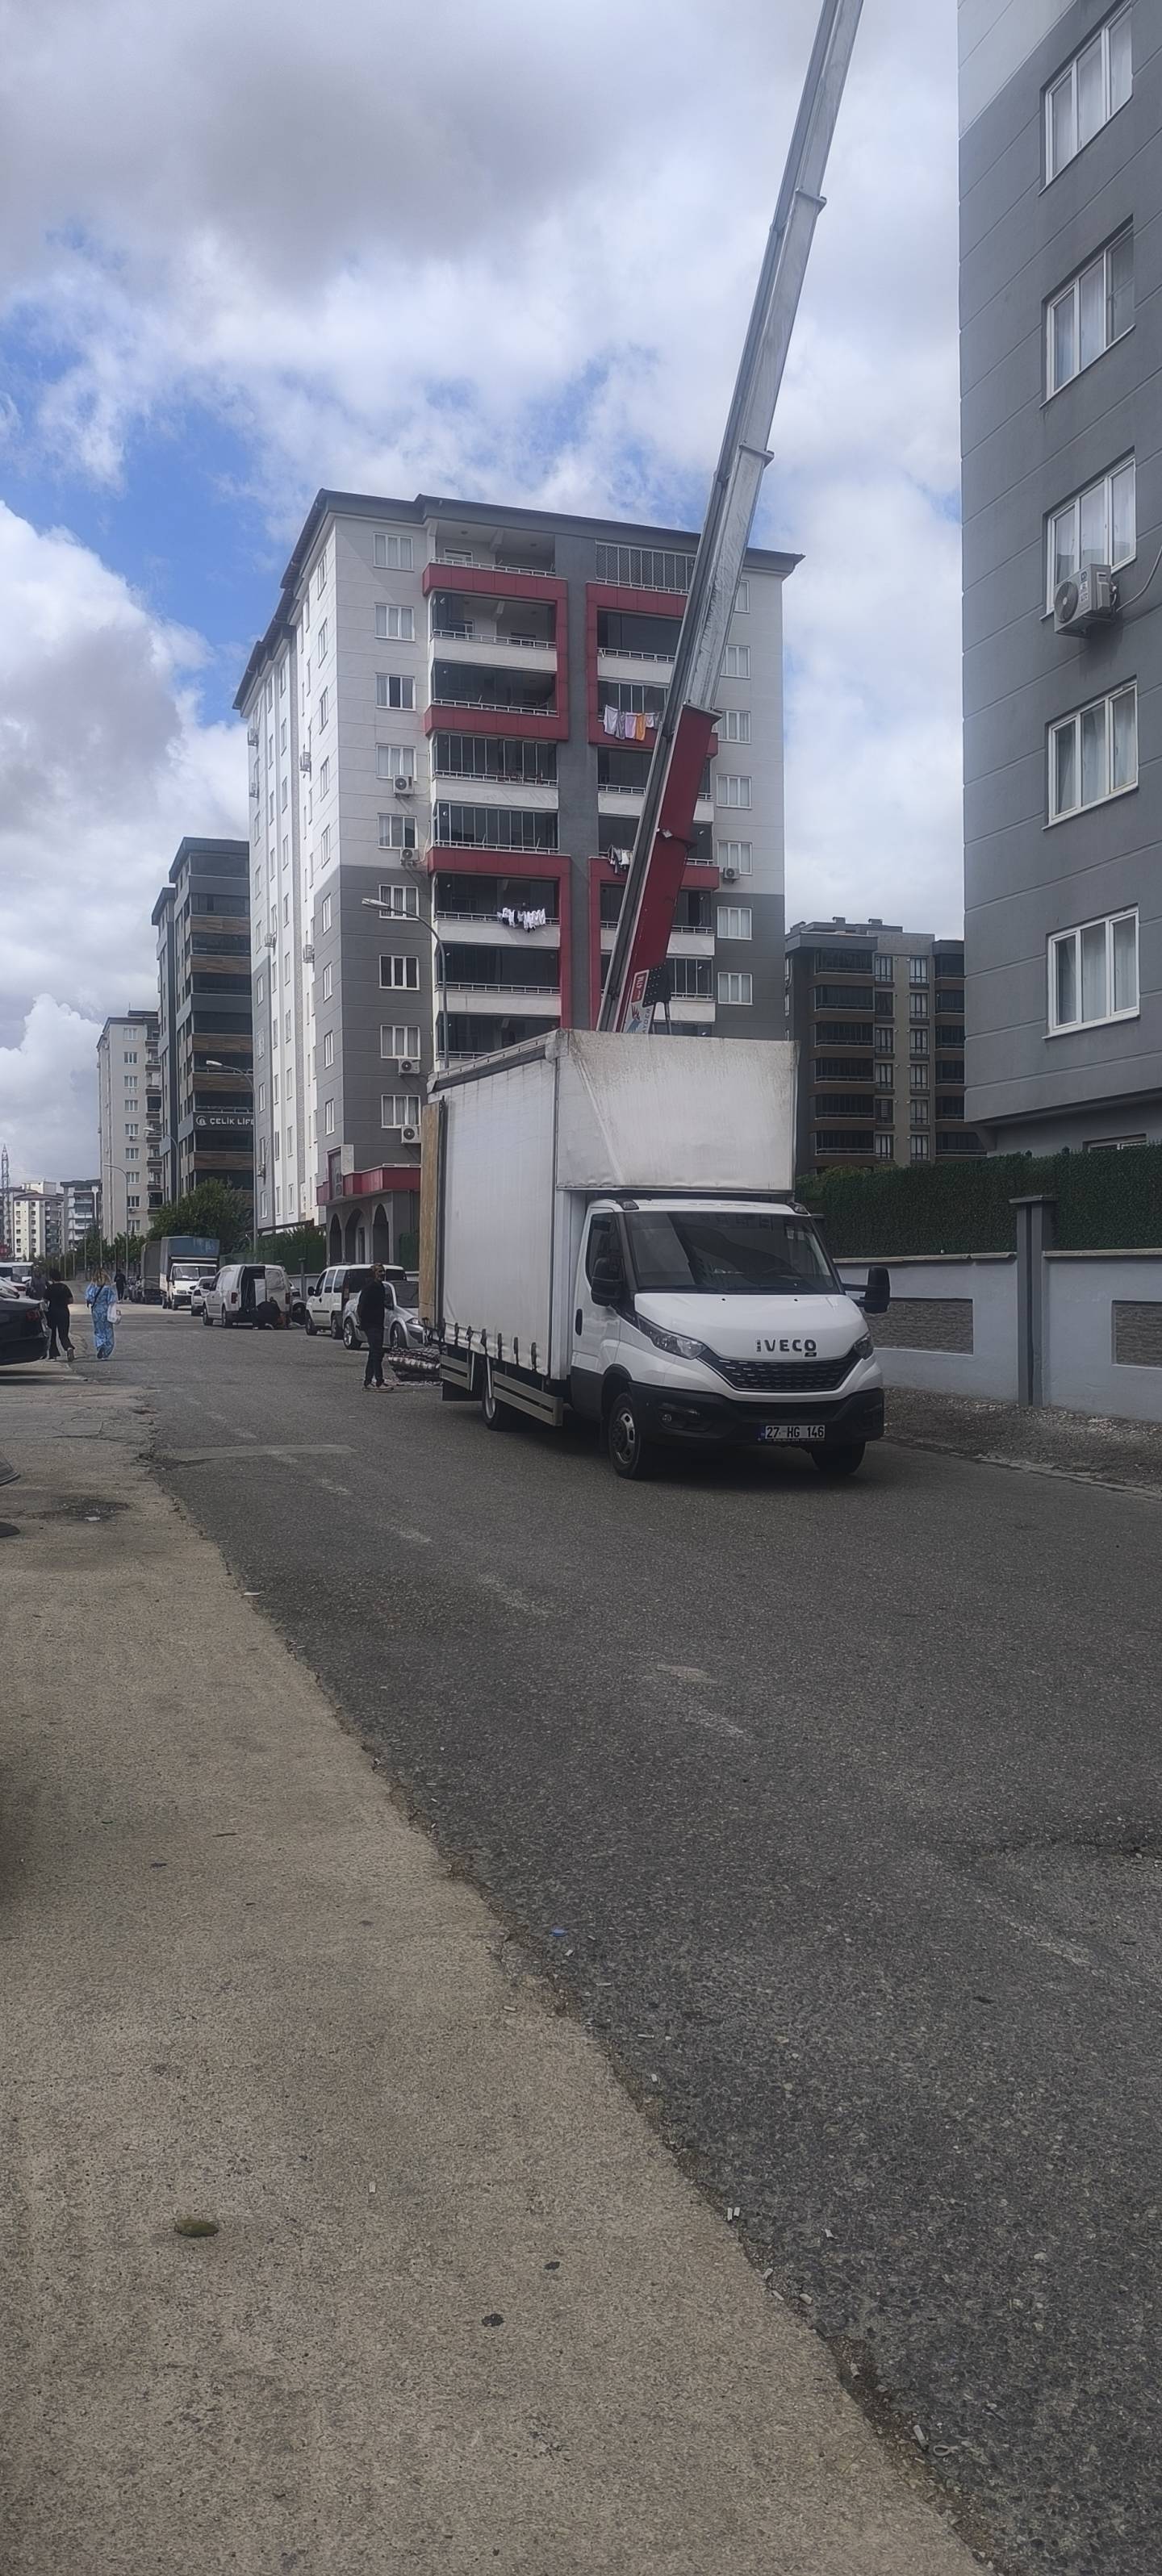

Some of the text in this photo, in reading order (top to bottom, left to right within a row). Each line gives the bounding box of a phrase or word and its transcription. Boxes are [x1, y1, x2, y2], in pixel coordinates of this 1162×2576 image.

[756, 1338, 817, 1353] IVECO
[767, 1426, 824, 1438] 27 HG 146
